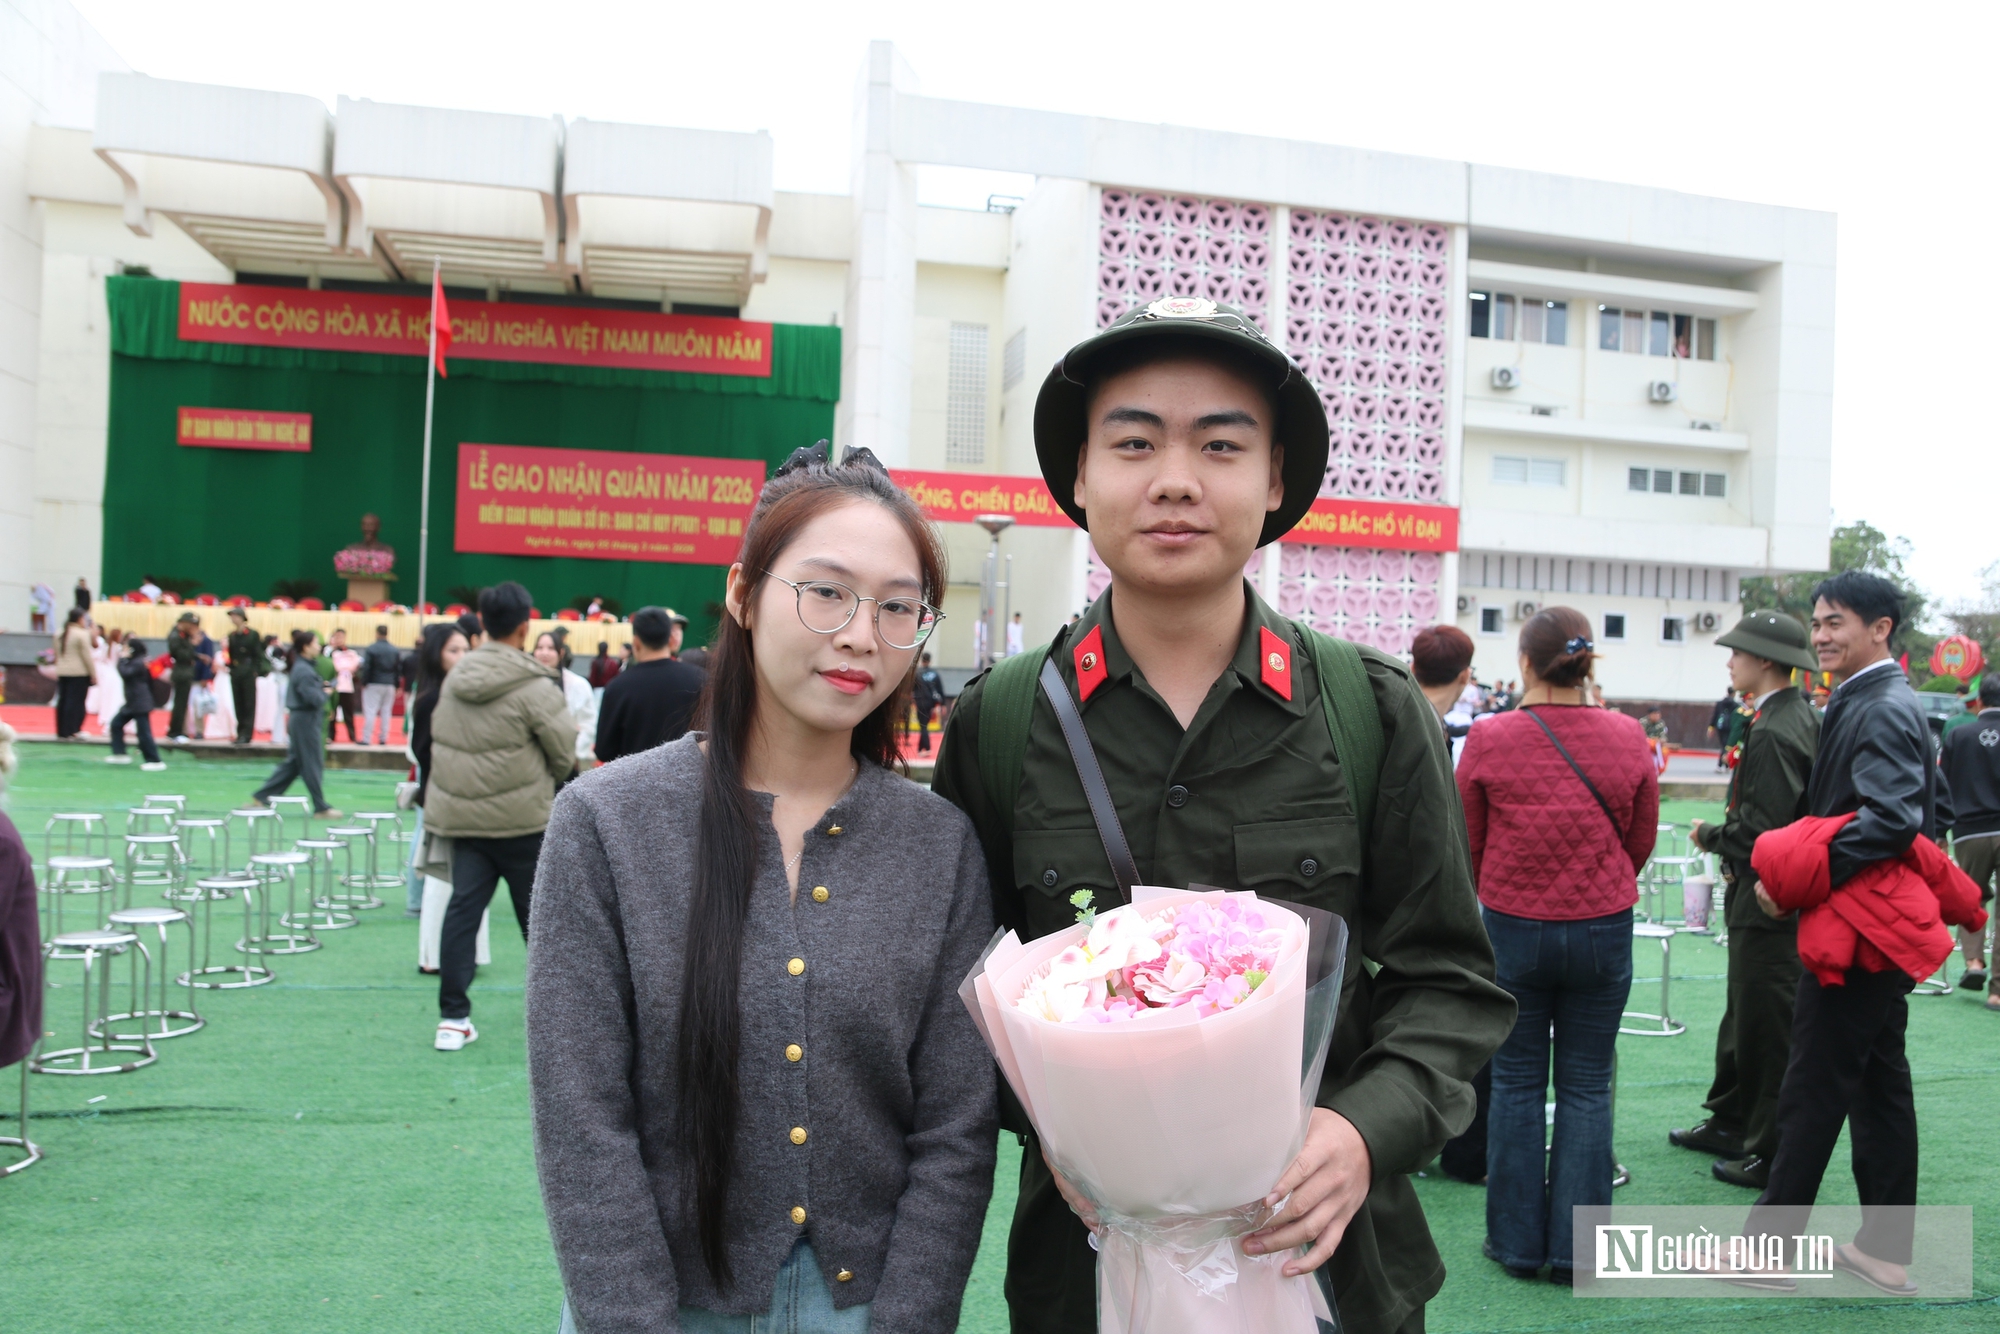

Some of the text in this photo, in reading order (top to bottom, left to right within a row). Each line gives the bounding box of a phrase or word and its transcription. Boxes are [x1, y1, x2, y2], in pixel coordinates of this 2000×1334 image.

[188, 295, 250, 329] NƯỚC
[254, 300, 320, 337] CỘNG
[324, 303, 369, 337] HÒA
[374, 307, 402, 339] XÃ
[450, 310, 489, 344] CHỦ
[494, 318, 557, 348] NGHĨA
[561, 320, 601, 357] VIỆT
[603, 327, 650, 355] NAM
[653, 327, 713, 359] MUÔN
[716, 330, 763, 362] NĂM
[469, 449, 754, 505] LỄ GIAO NHẬN QUÂN NĂM 2026
[505, 505, 527, 526] GIAO
[528, 503, 555, 531] NHẬN
[557, 505, 583, 530] QUÂN
[960, 485, 1010, 513] CHIẾN
[1012, 486, 1053, 518] ĐẤU,
[1339, 509, 1371, 535] BÁC
[1373, 509, 1397, 537] HỒ
[1398, 514, 1413, 537] VĨ
[1415, 519, 1442, 543] ĐẠI
